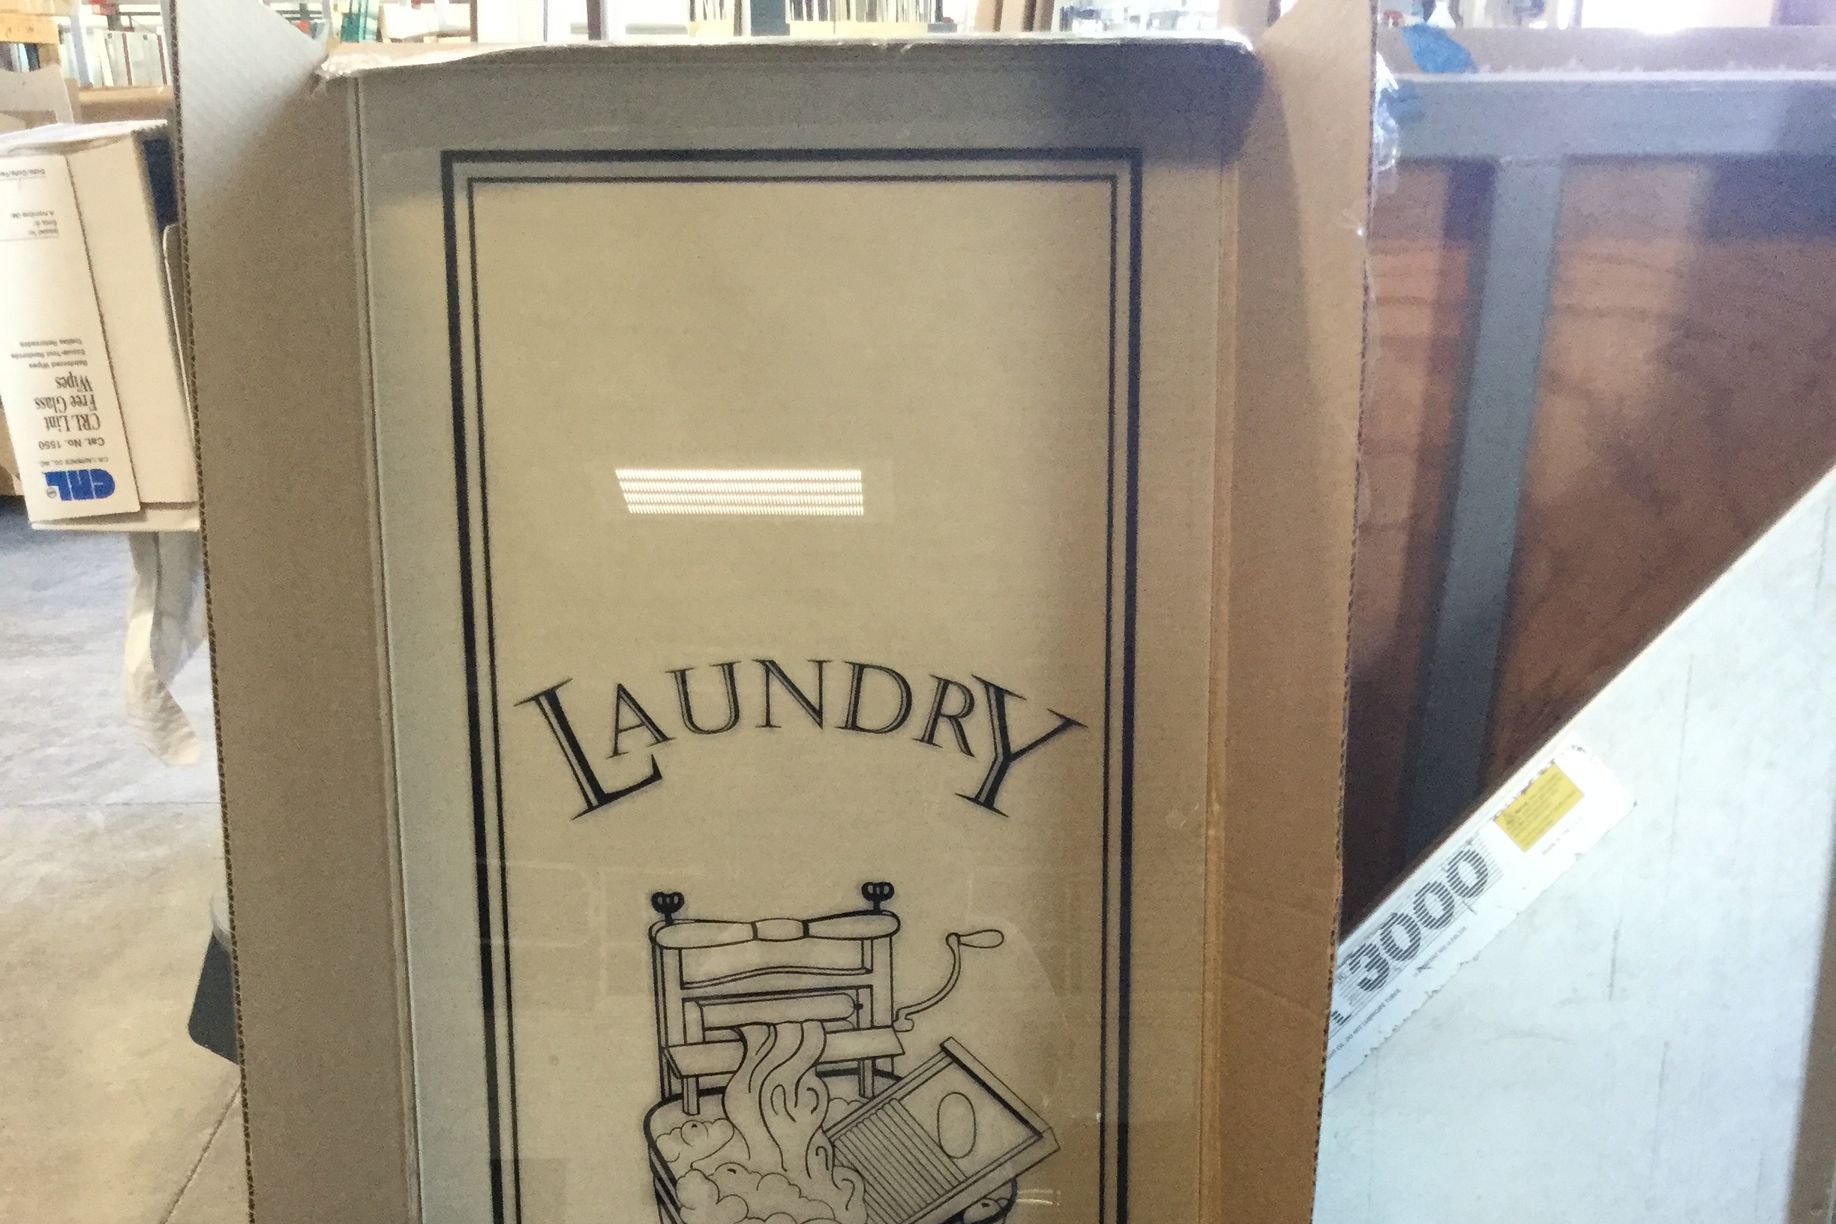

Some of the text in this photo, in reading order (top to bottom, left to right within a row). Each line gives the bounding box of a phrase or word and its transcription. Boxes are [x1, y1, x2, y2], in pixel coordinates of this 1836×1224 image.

[55, 371, 94, 393] Wipes
[34, 394, 98, 414] Free Glass
[43, 412, 101, 433] CRL Lint
[38, 437, 105, 450] Cat. No. 1550
[45, 468, 116, 502] CRL
[514, 658, 1087, 819] LAUNDRY
[1348, 847, 1491, 993] 3000
